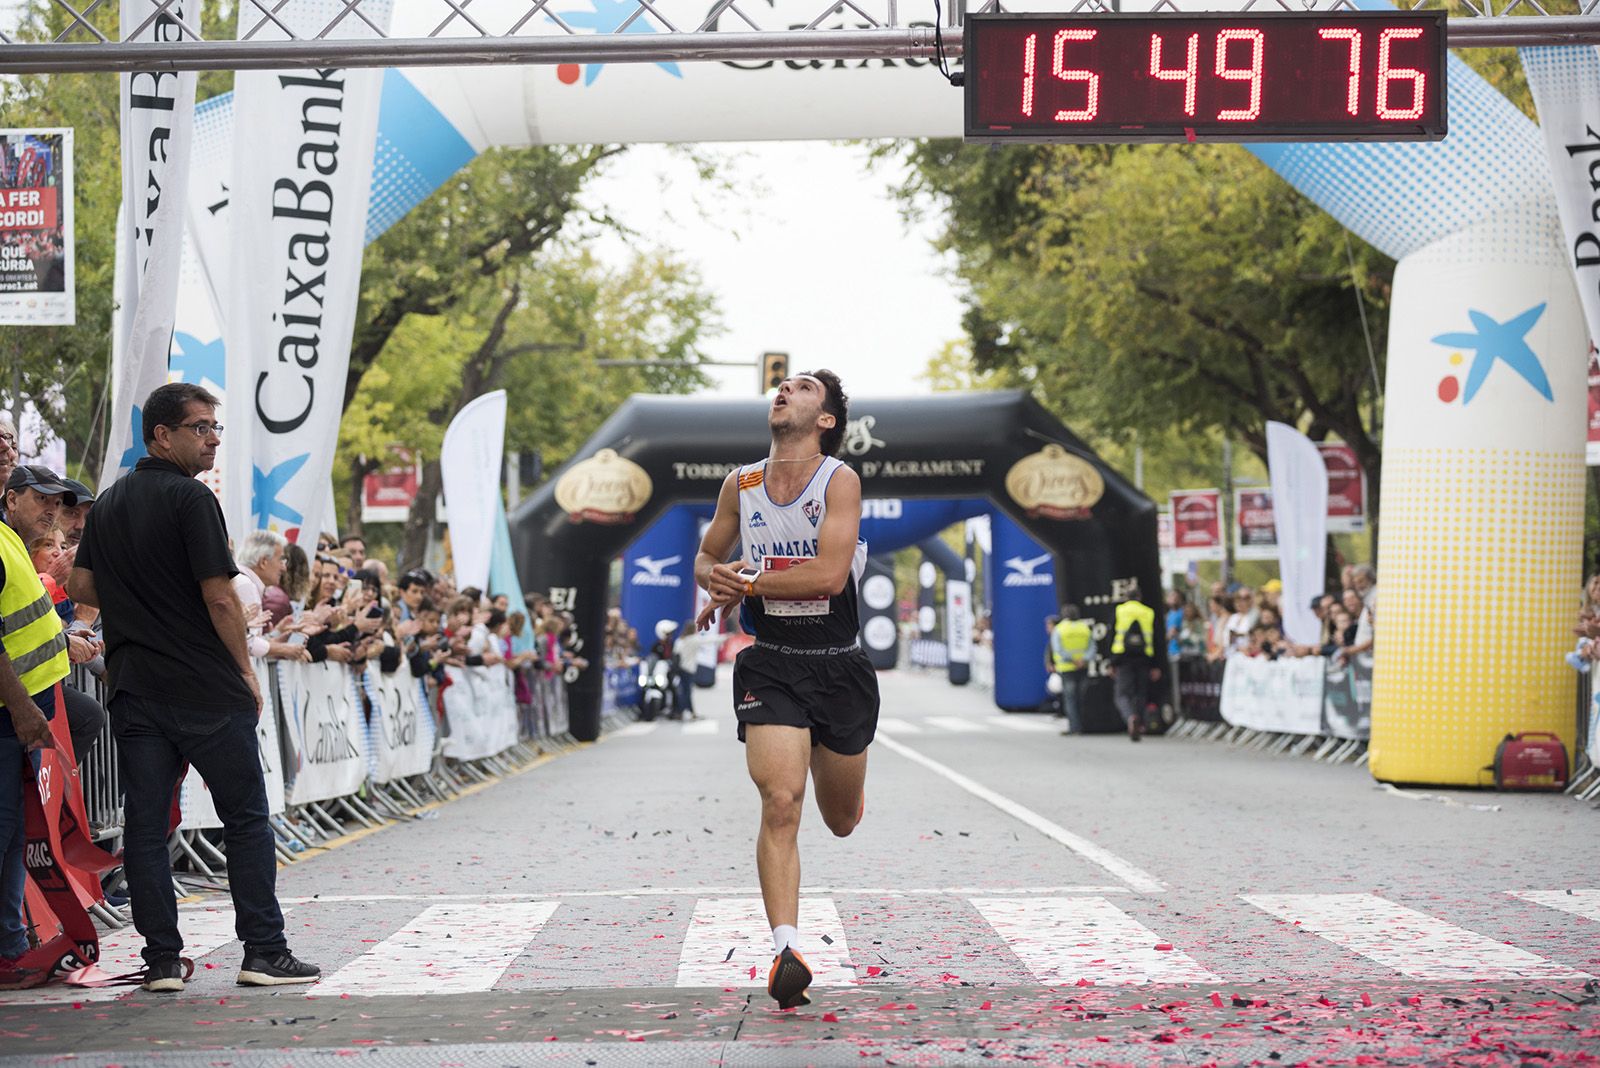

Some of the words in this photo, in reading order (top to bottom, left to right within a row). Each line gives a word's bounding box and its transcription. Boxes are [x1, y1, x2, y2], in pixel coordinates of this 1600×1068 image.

[1022, 29, 1099, 121] 15
[1149, 28, 1264, 121] 49
[1318, 28, 1426, 120] 76
[9, 190, 40, 207] FER
[255, 68, 347, 435] CaixaBank
[672, 462, 738, 480] TORRO
[862, 459, 985, 478] D'AGRAMUNT
[26, 841, 54, 868] RAC
